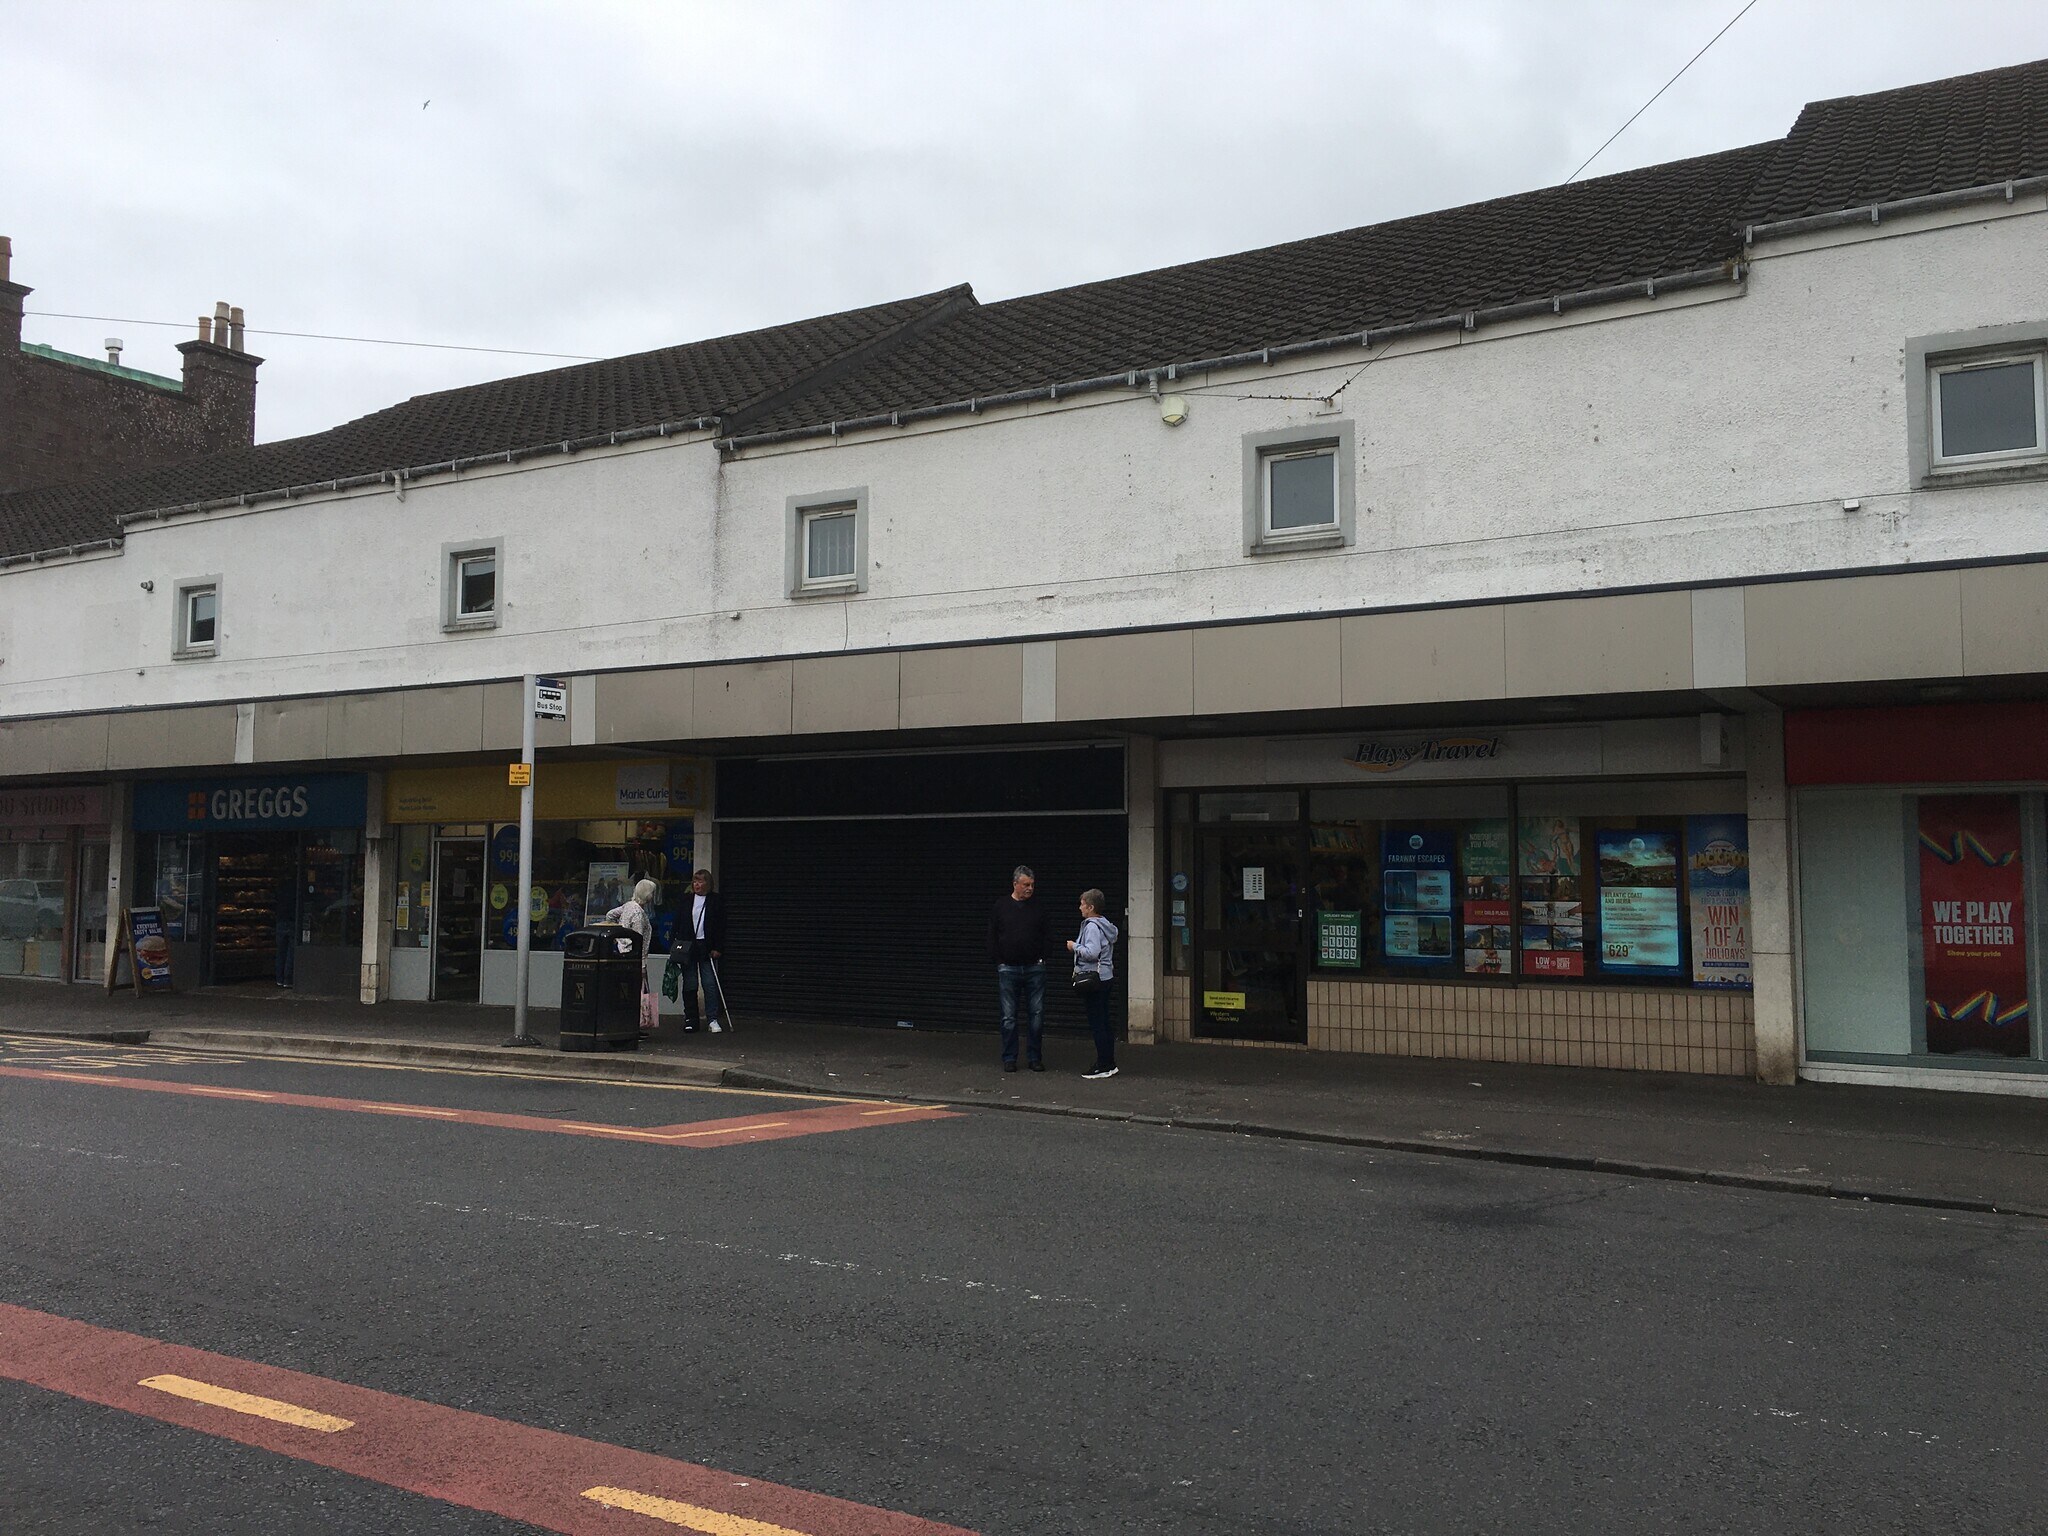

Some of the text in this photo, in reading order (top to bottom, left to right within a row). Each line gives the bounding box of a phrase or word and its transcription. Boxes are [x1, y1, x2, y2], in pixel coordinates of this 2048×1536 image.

[537, 701, 563, 711] Bus Stop
[1355, 737, 1498, 766] Hays Travel
[211, 785, 309, 820] GREGGS
[620, 788, 644, 800] Marie
[645, 788, 669, 799] Curie
[1388, 854, 1446, 863] FARAWAY ESCAPES
[1707, 906, 1739, 926] WIN
[1932, 901, 2013, 923] WE PLAY
[1703, 926, 1746, 947] 1 OF 4
[1932, 925, 2015, 945] TOGETHER
[1535, 956, 1550, 964] LOW
[1965, 950, 1983, 958] your
[1983, 949, 2001, 958] pride
